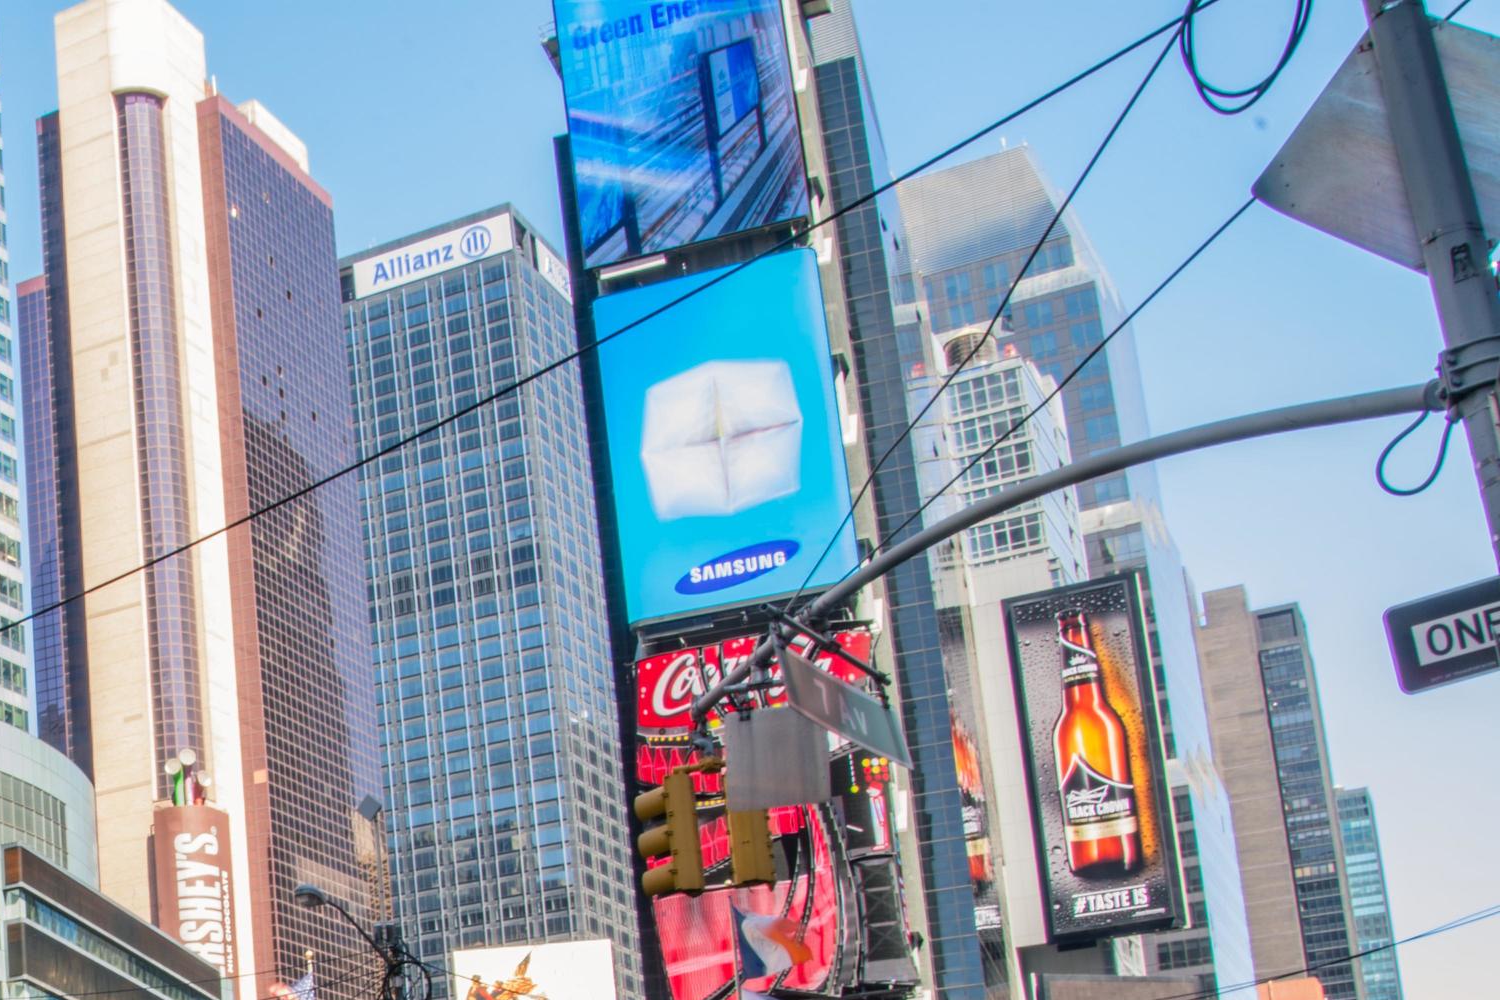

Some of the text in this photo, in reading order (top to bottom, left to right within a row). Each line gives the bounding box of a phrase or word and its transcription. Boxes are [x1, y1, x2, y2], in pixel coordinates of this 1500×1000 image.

[572, 13, 645, 51] Green
[373, 243, 455, 286] Allianz
[690, 550, 786, 584] SAMSUNG
[1426, 605, 1500, 656] ONE
[812, 678, 832, 715] 7
[174, 832, 226, 978] RSHEY'S
[1074, 886, 1148, 914] #TASTE IS
